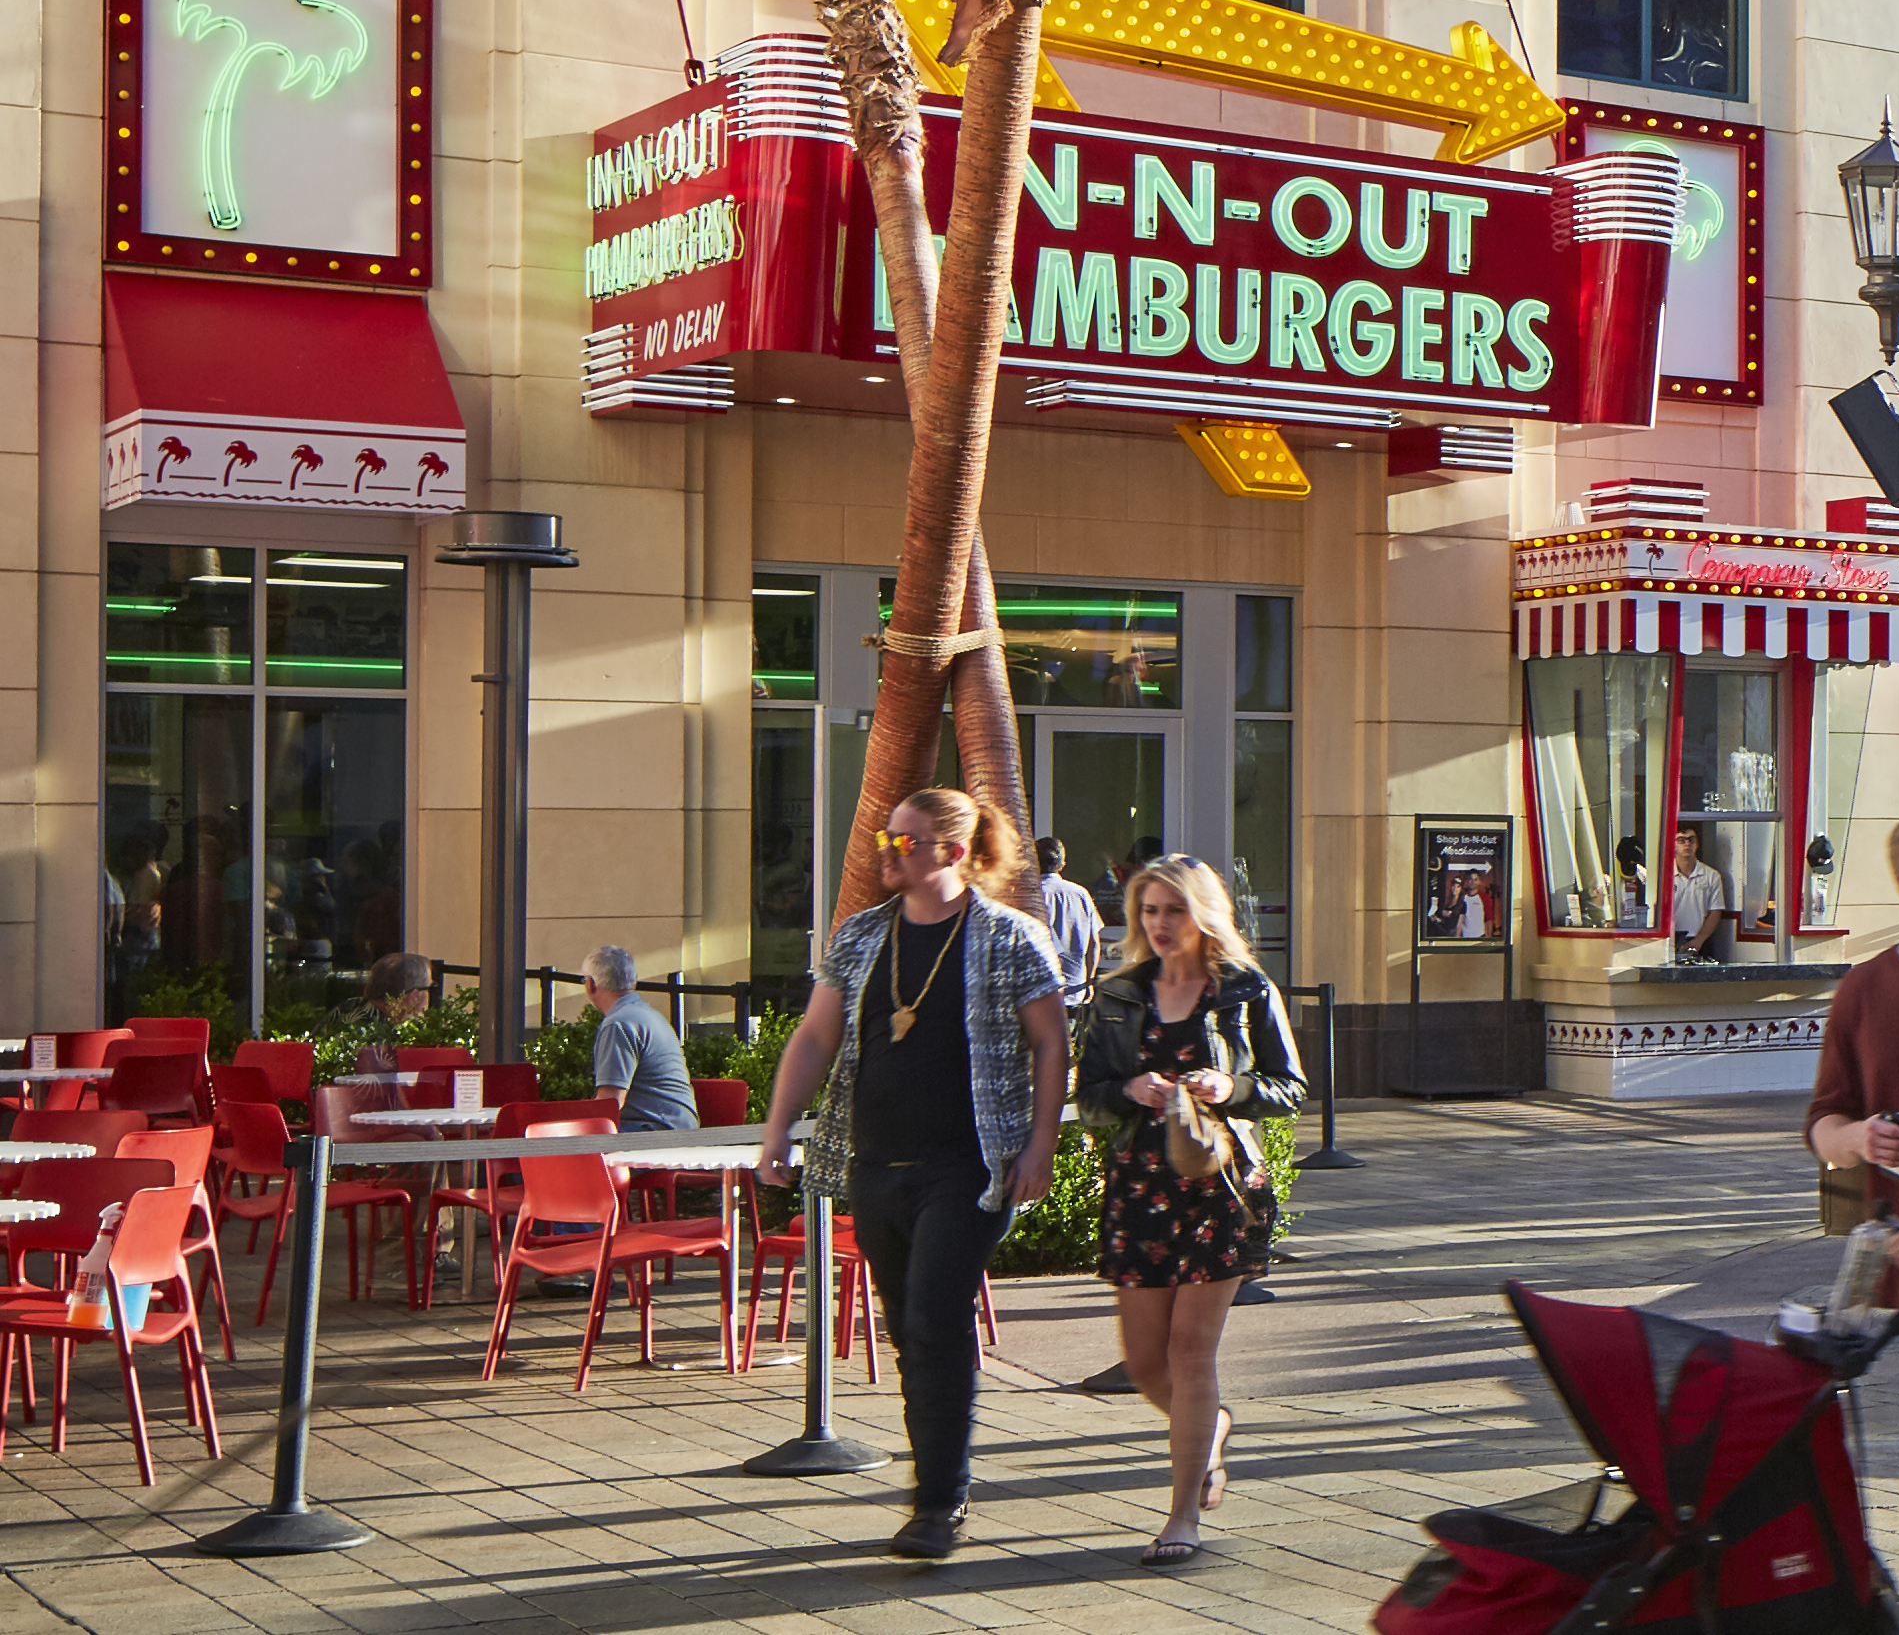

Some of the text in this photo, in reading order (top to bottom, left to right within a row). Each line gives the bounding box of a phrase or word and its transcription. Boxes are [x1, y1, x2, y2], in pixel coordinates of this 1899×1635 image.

[586, 104, 731, 212] IN-N-OUT
[1020, 143, 1488, 274] N-N-OUT
[585, 195, 745, 302] HAMBURGERS
[643, 301, 725, 361] NO DELAY
[873, 227, 1554, 393] MBURGERS
[1687, 539, 1890, 598] Company Store
[1436, 834, 1460, 845] Shop
